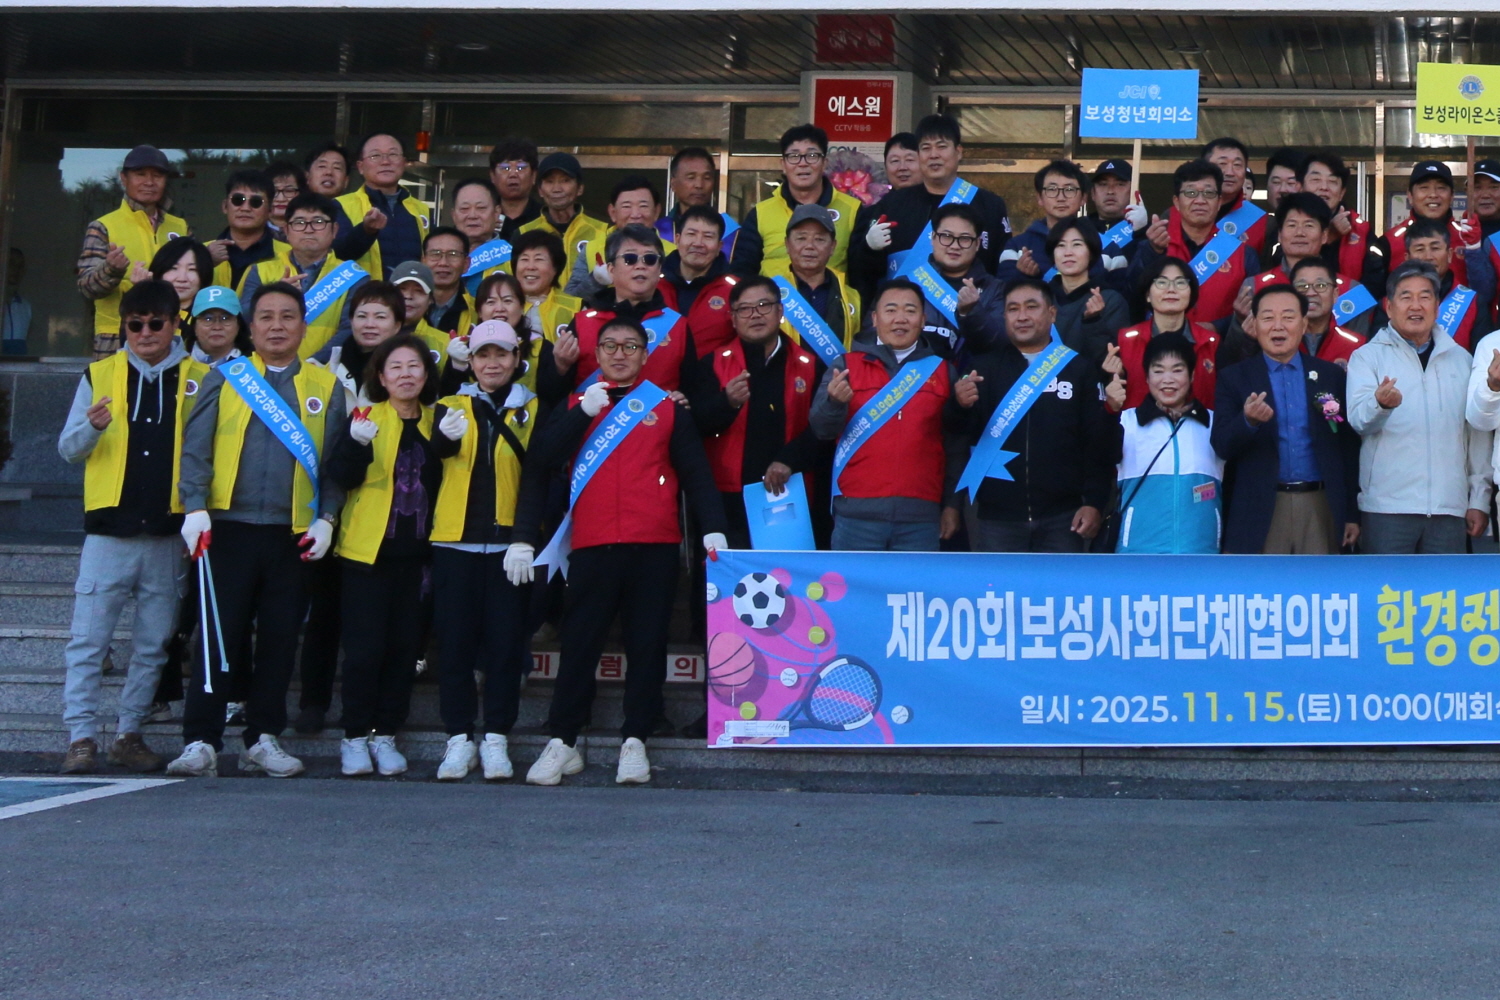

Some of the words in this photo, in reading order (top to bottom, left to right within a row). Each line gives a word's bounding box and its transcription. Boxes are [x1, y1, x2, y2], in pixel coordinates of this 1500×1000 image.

[1118, 84, 1147, 100] JCI
[828, 95, 881, 117] 에스원
[1084, 105, 1193, 124] 보성청년회의소
[834, 124, 853, 132] CCTV
[208, 288, 222, 303] P
[886, 591, 1358, 662] 제20회보성사회단체협의회
